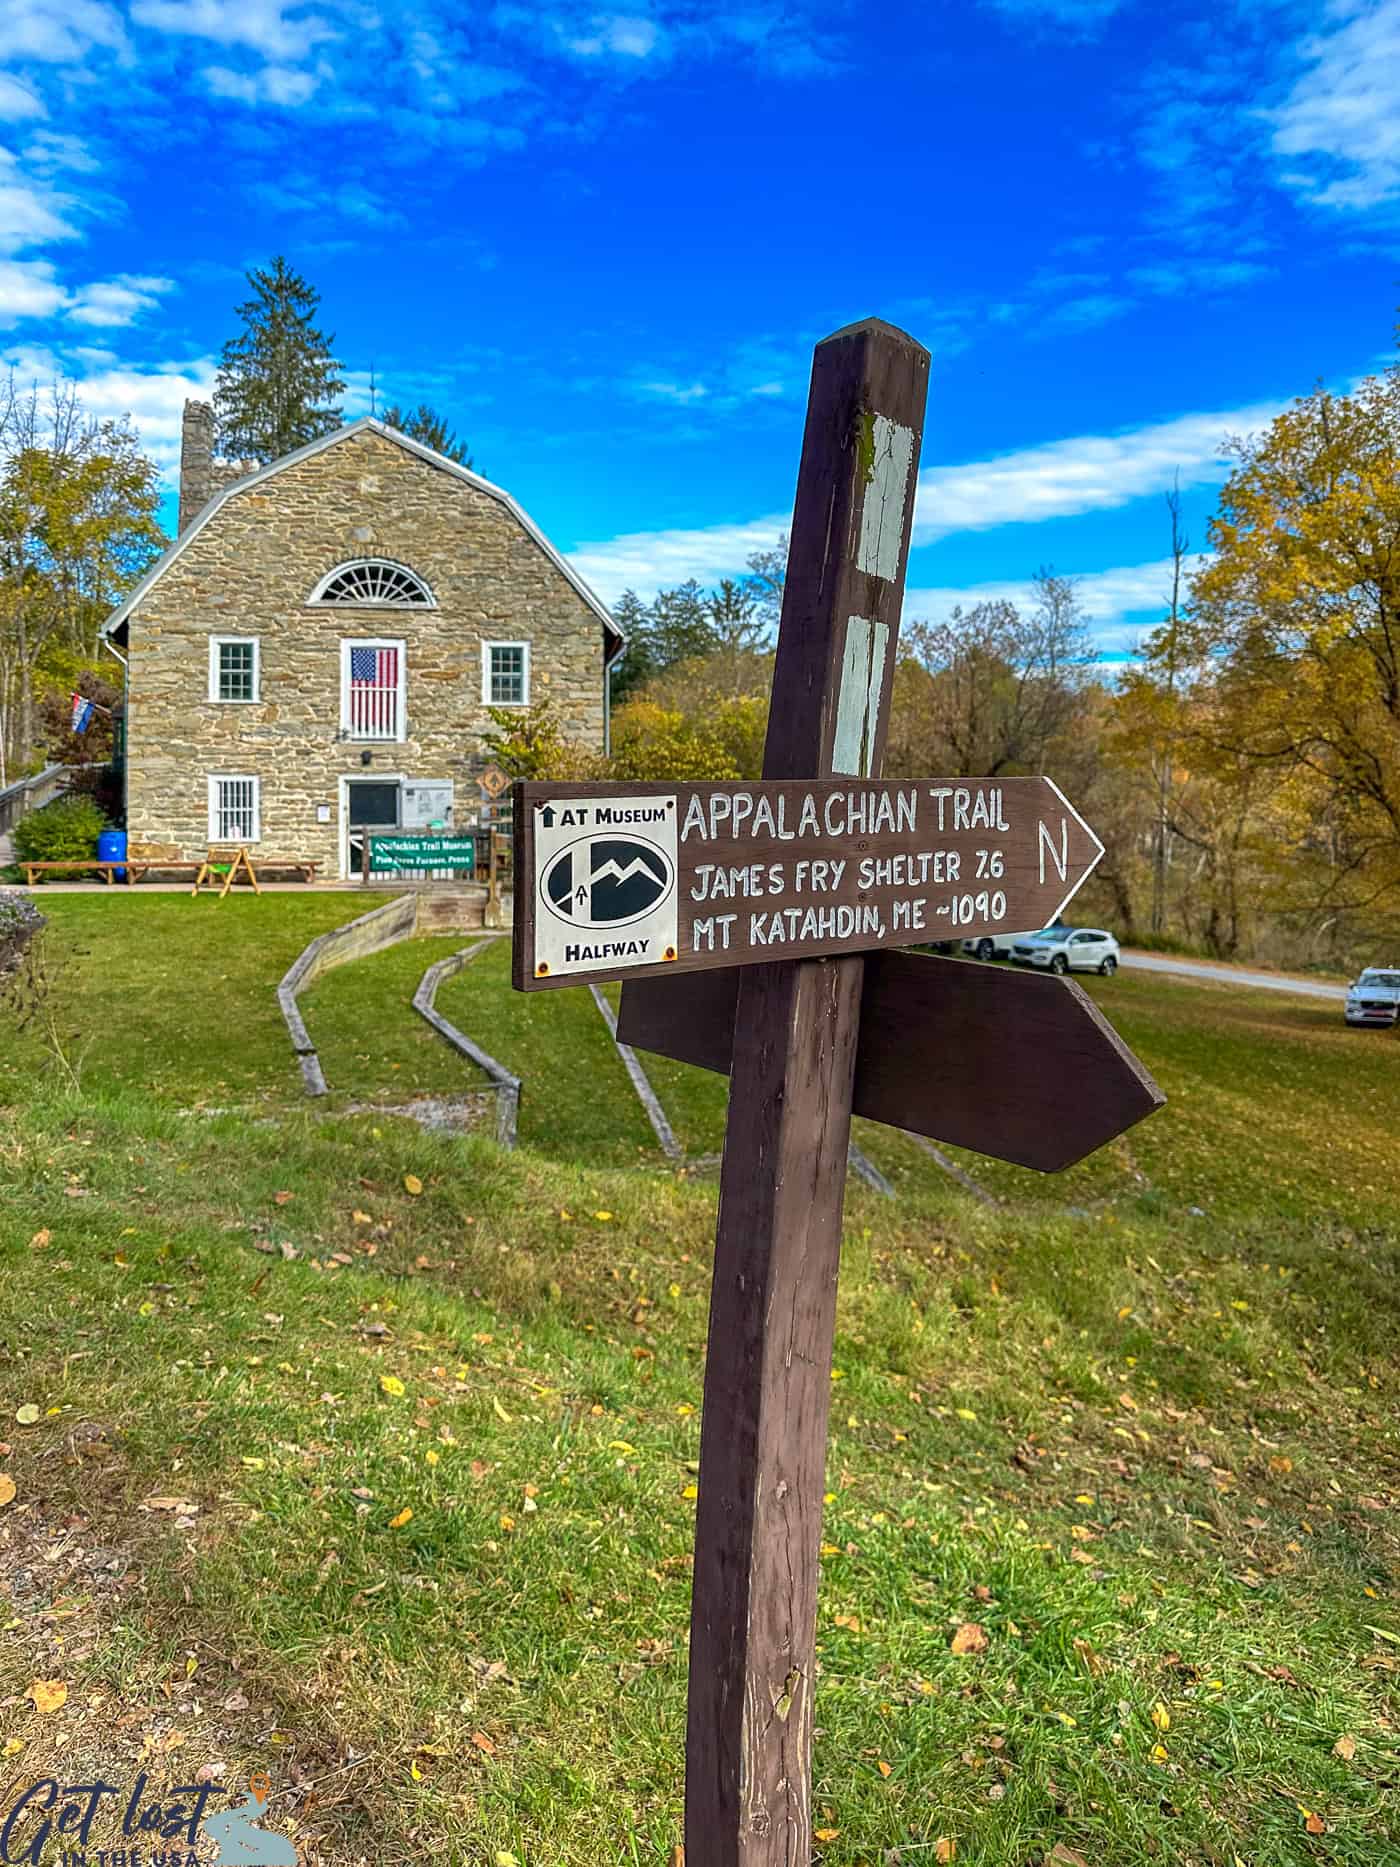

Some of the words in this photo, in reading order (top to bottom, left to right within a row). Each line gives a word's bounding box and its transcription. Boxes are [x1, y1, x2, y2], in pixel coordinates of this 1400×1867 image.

[560, 809, 588, 826] AT
[595, 808, 666, 824] MUSEUM
[680, 789, 918, 842] APPALACHIAN
[929, 787, 1010, 832] TRAIL
[690, 863, 785, 901] JAMES
[795, 858, 846, 892] FRY
[857, 850, 961, 890] SHELTER
[975, 849, 1005, 880] 7.6
[1037, 817, 1068, 885] N
[565, 939, 650, 962] HALFWAY
[693, 913, 738, 951] MT
[750, 904, 886, 946] KATAHDIN,
[893, 898, 927, 930] ME
